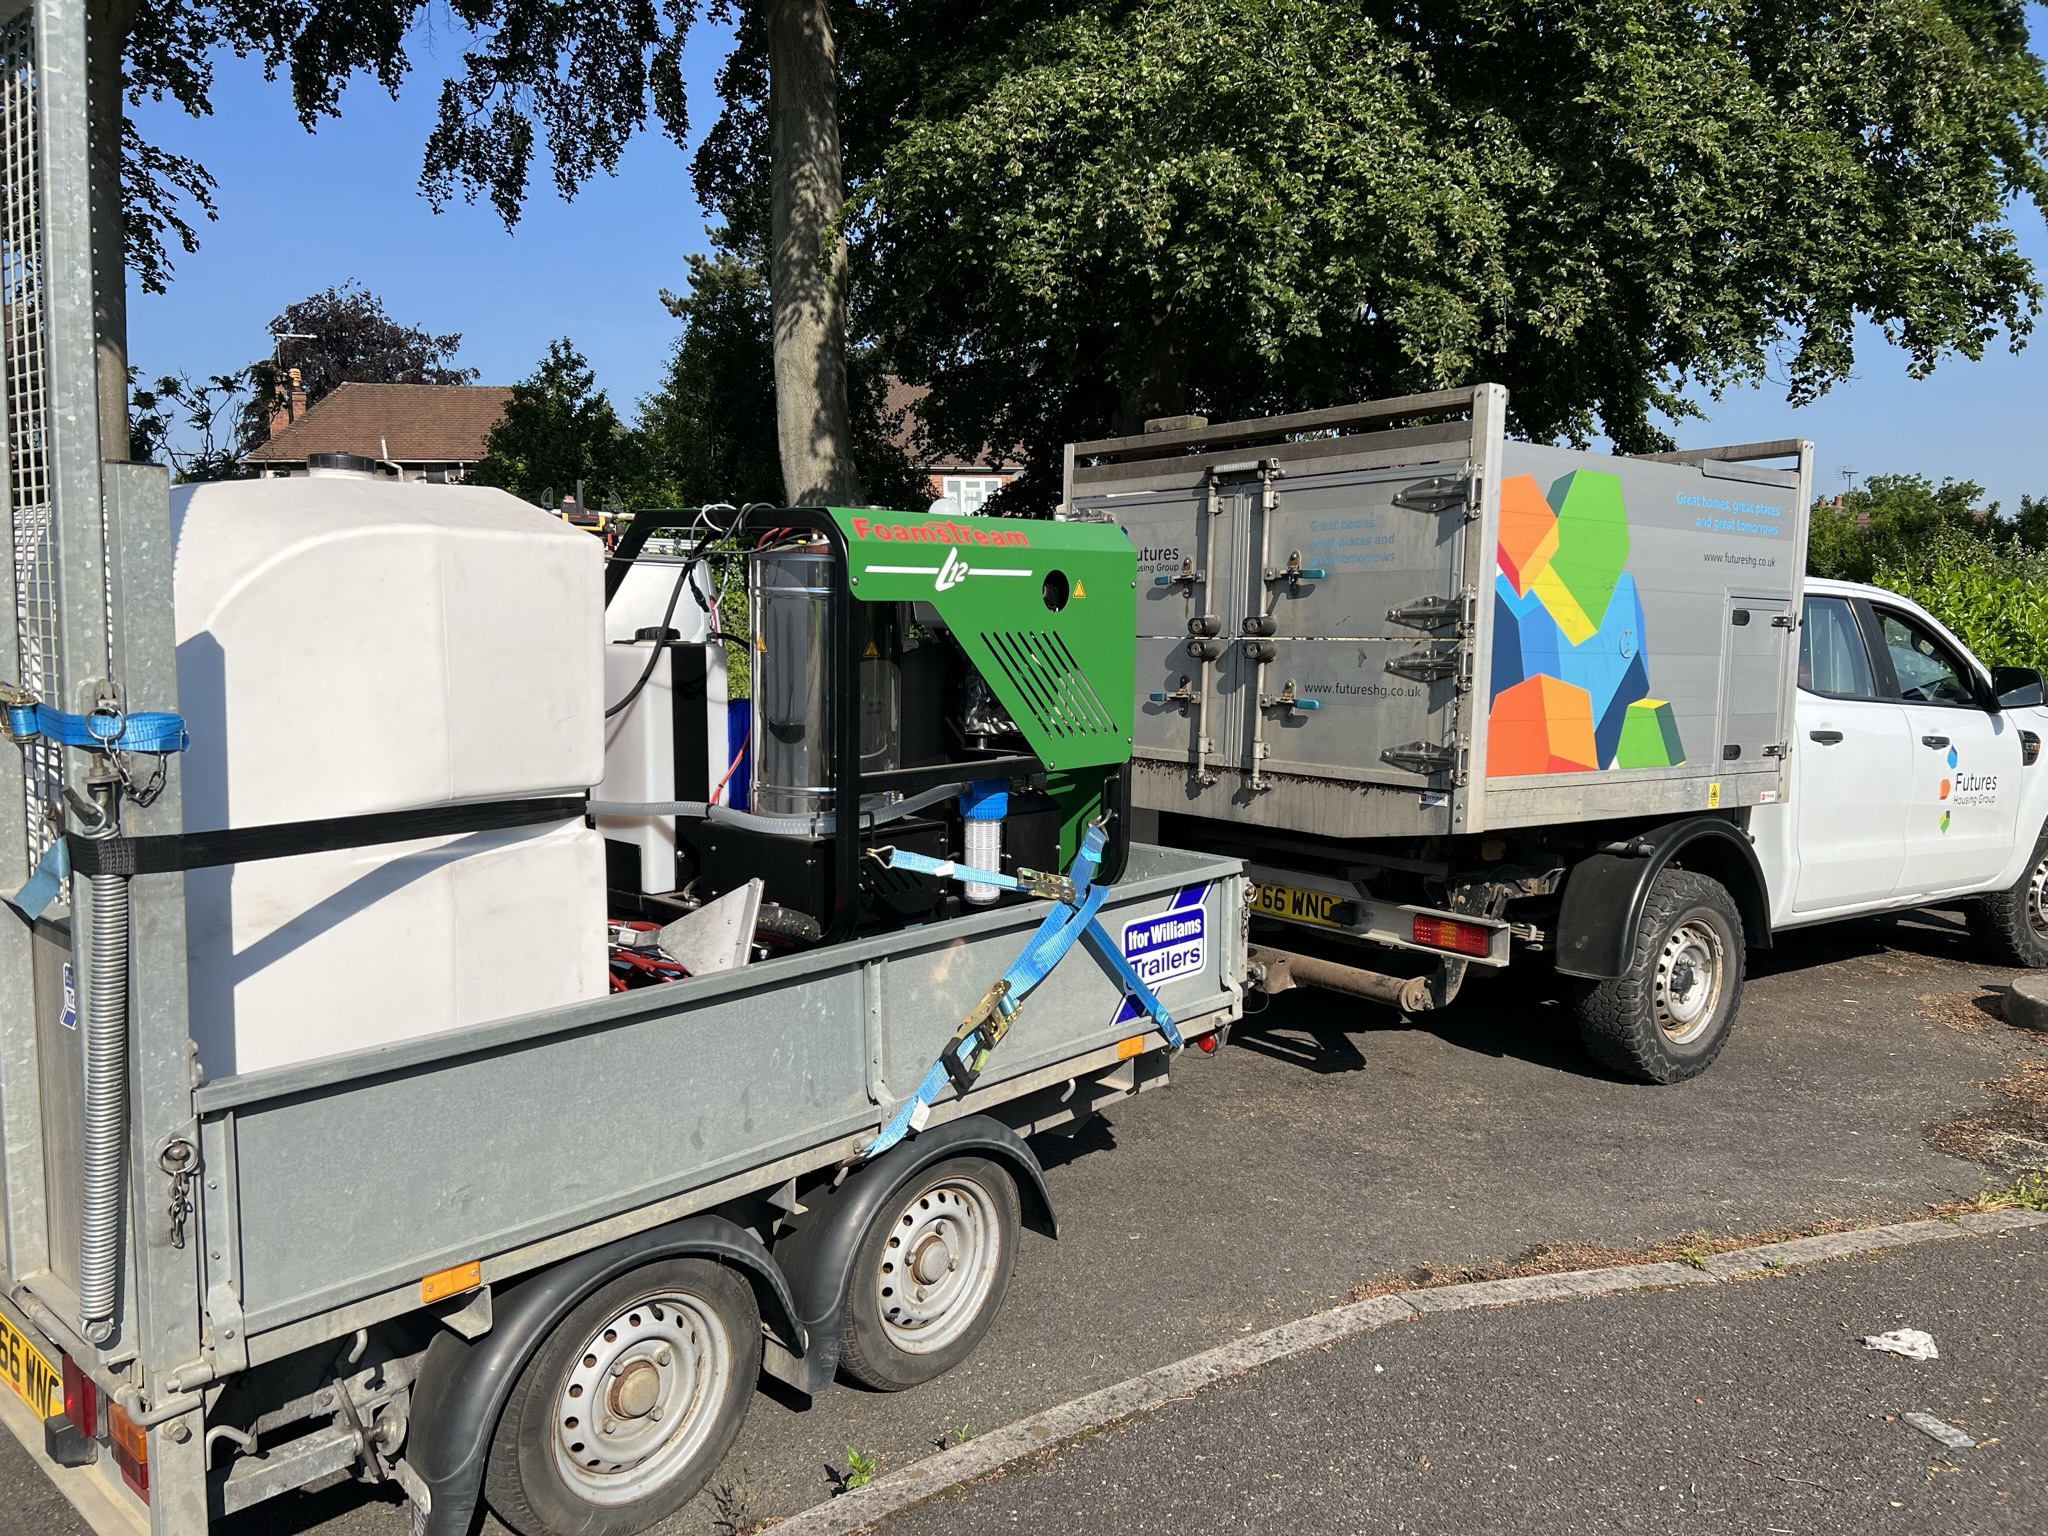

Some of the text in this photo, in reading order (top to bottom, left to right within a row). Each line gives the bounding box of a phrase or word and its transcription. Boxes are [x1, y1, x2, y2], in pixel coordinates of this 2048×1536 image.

[1677, 491, 1780, 517] Great homes, great places
[851, 518, 1031, 547] Foamstream
[1311, 520, 1338, 531] Great
[1696, 516, 1779, 535] and great tomorrows
[1309, 532, 1395, 551] great places and
[1137, 547, 1179, 561] utures
[1309, 552, 1396, 567] great tomorrows
[1704, 552, 1776, 568] www.futureshg.co.uk
[935, 546, 969, 591] L12
[1137, 563, 1179, 573] using Group
[1304, 682, 1421, 698] www.futureshg.co.uk
[1955, 772, 1998, 791] Futures
[1953, 794, 1996, 806] Housing Group
[1128, 918, 1202, 951] Ifor Williams
[1129, 947, 1201, 979] Trailers
